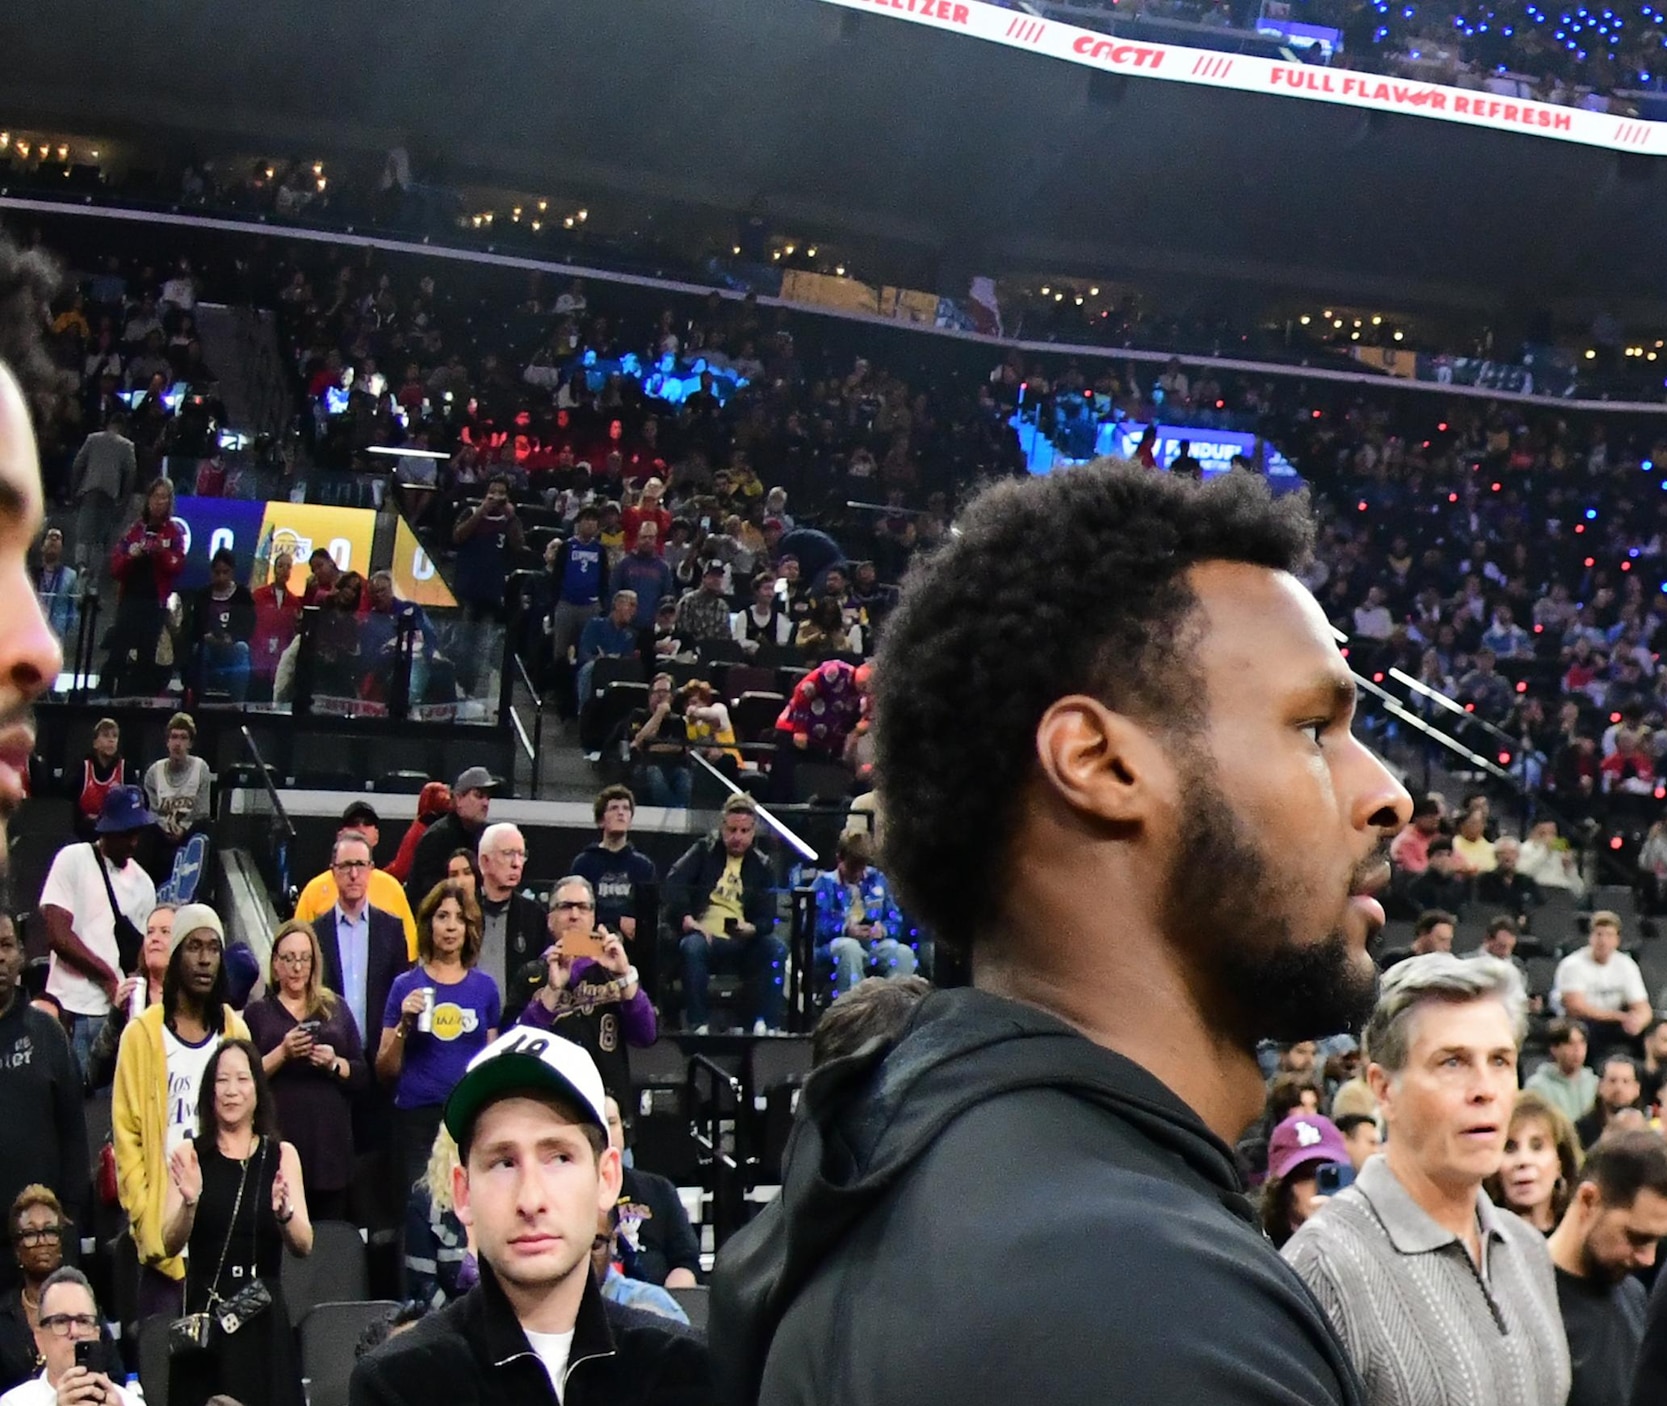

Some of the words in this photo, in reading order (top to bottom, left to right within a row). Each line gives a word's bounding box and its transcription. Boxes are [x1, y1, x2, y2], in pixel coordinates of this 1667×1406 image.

[862, 0, 970, 24] LTZER
[1072, 36, 1166, 69] CACTI
[1270, 67, 1334, 93] FULL
[1454, 96, 1571, 131] REFRESH
[600, 1013, 619, 1052] 8
